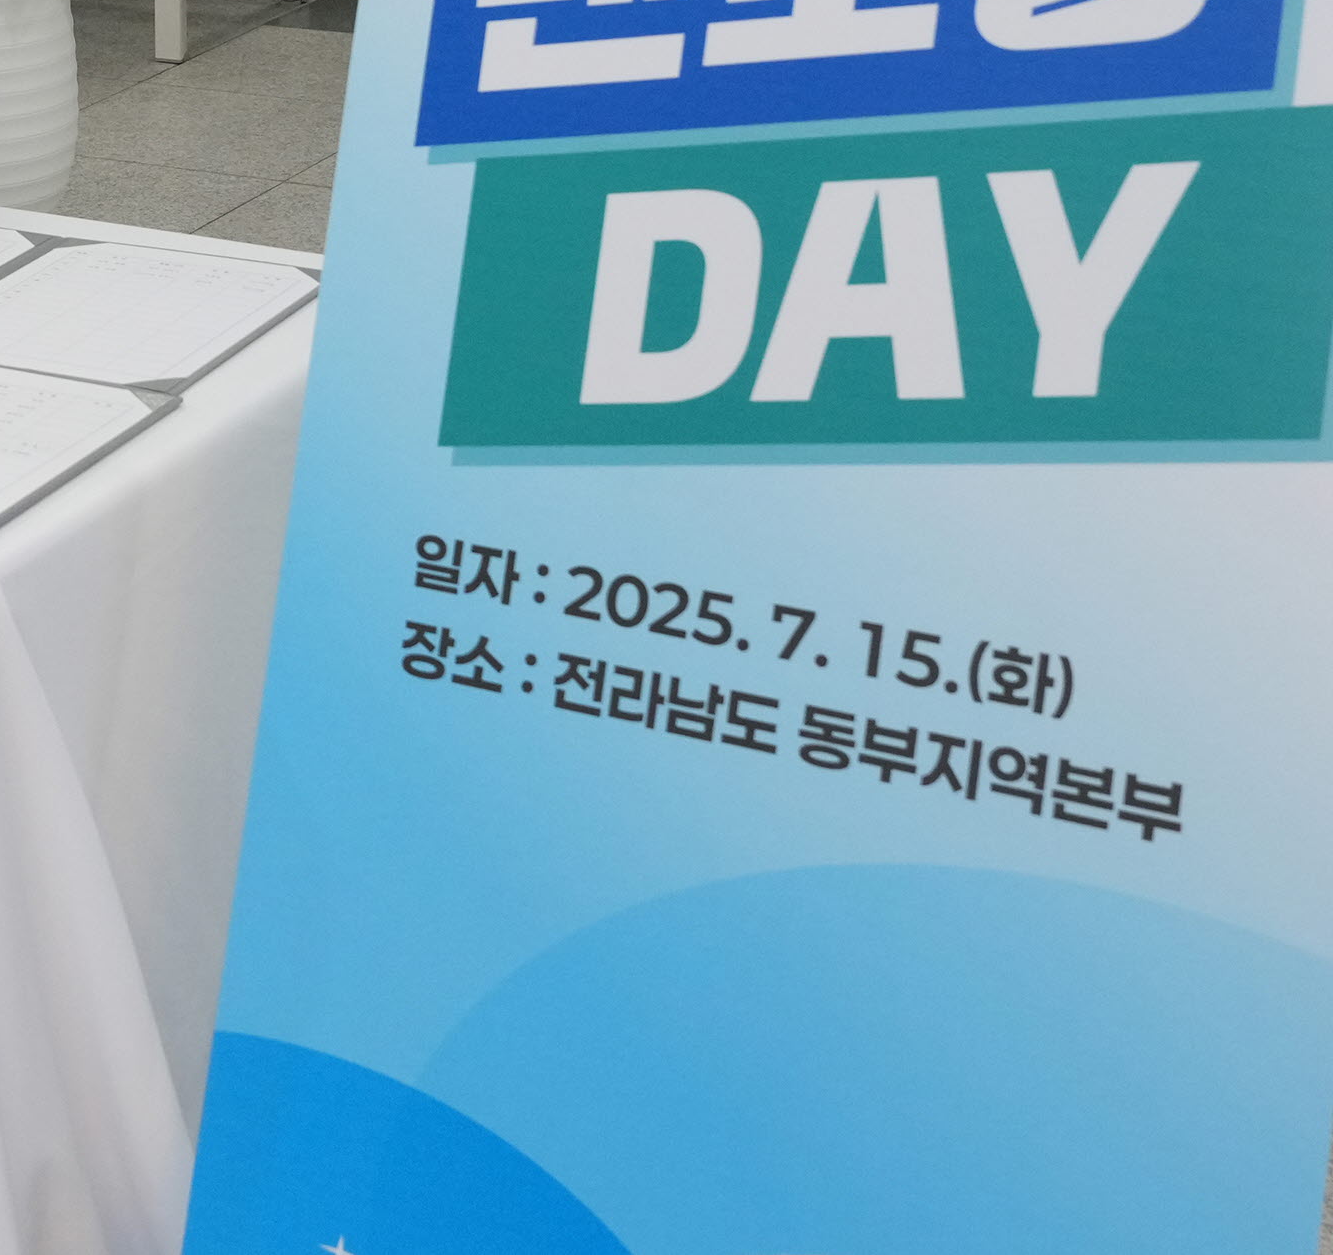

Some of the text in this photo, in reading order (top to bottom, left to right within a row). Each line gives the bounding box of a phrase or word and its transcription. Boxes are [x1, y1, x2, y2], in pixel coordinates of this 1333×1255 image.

[579, 160, 1202, 405] DAY
[401, 619, 505, 694] 장소
[553, 651, 781, 755] 전라남도
[797, 702, 1184, 843] 동부지역본부
[415, 534, 520, 606] 일자
[563, 565, 751, 652] 2025.
[771, 603, 829, 669] 7.
[859, 619, 1076, 720] 15.(화)
